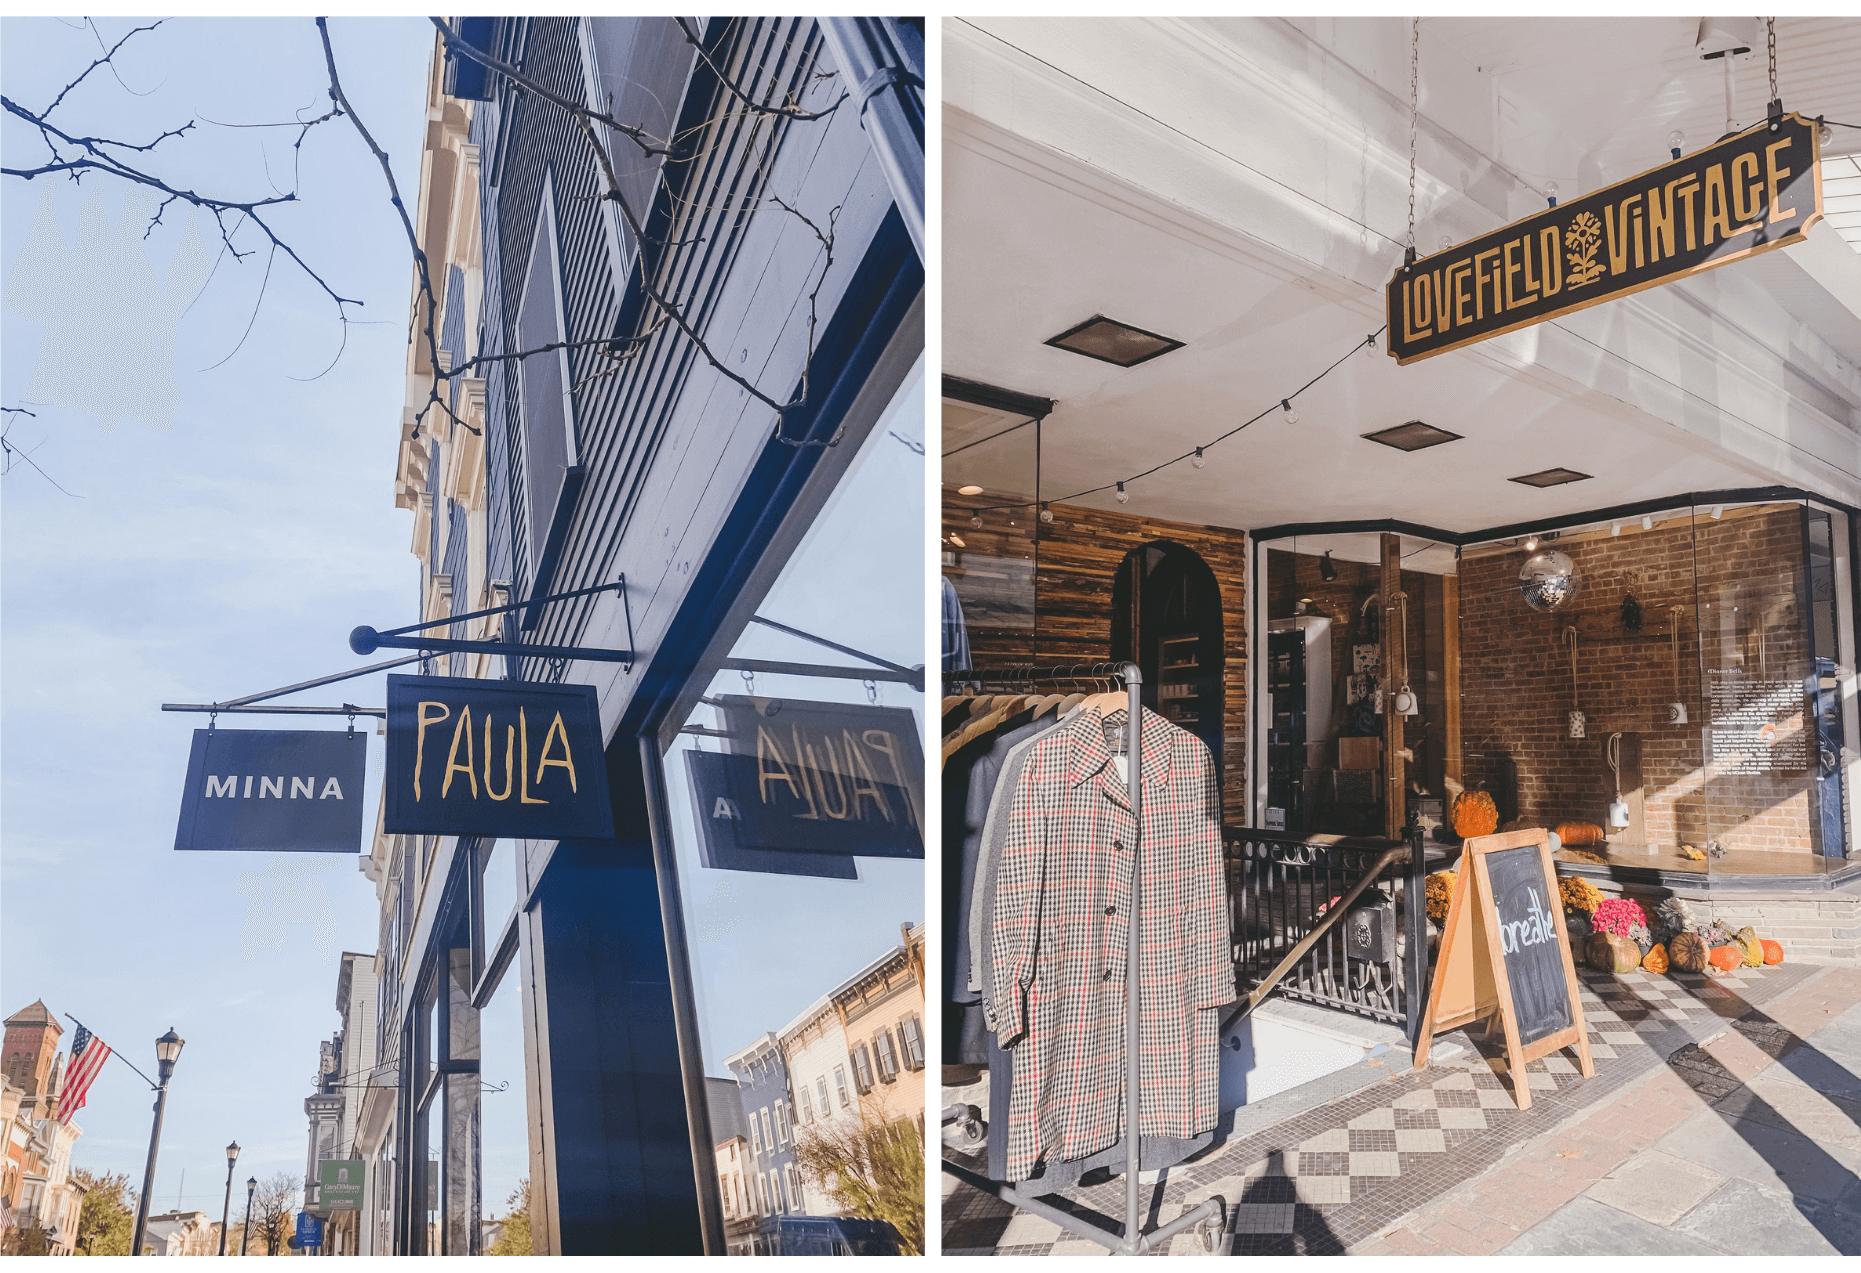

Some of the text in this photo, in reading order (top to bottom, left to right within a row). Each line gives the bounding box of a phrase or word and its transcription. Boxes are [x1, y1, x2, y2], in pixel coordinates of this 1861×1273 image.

[1604, 136, 1797, 276] VINTAGE
[204, 774, 345, 801] MINNA
[413, 701, 578, 804] PAULA
